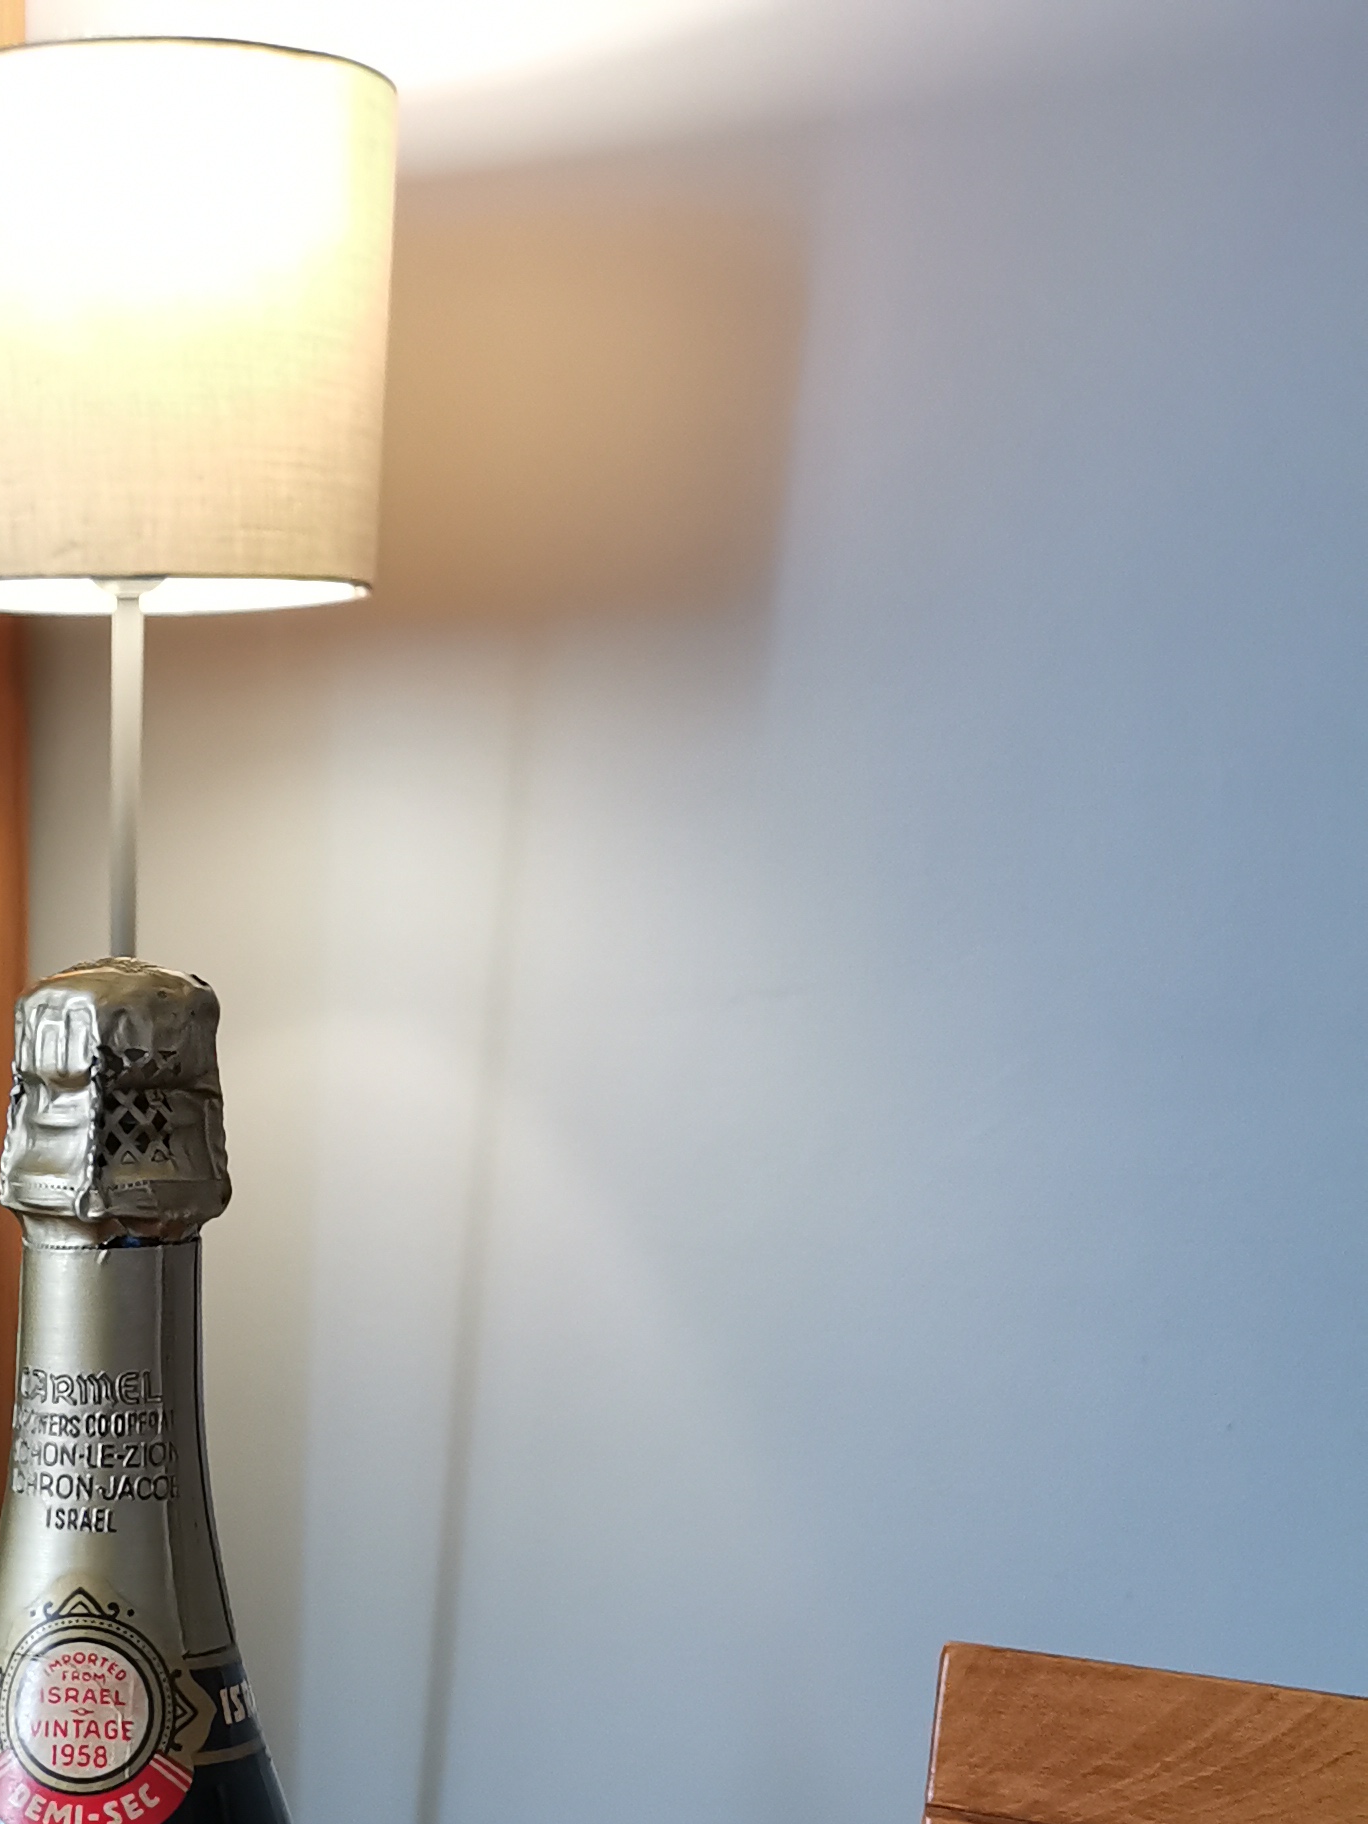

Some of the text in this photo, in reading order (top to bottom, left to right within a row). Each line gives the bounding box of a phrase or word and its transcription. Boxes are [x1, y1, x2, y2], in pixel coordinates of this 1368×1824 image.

[45, 1506, 118, 1533] ISRAEL
[43, 1651, 128, 1682] IMPORTED
[61, 1670, 107, 1686] FROM
[40, 1686, 127, 1707] ISRAEL
[30, 1719, 135, 1742] VINTAGE
[51, 1743, 108, 1769] 1958
